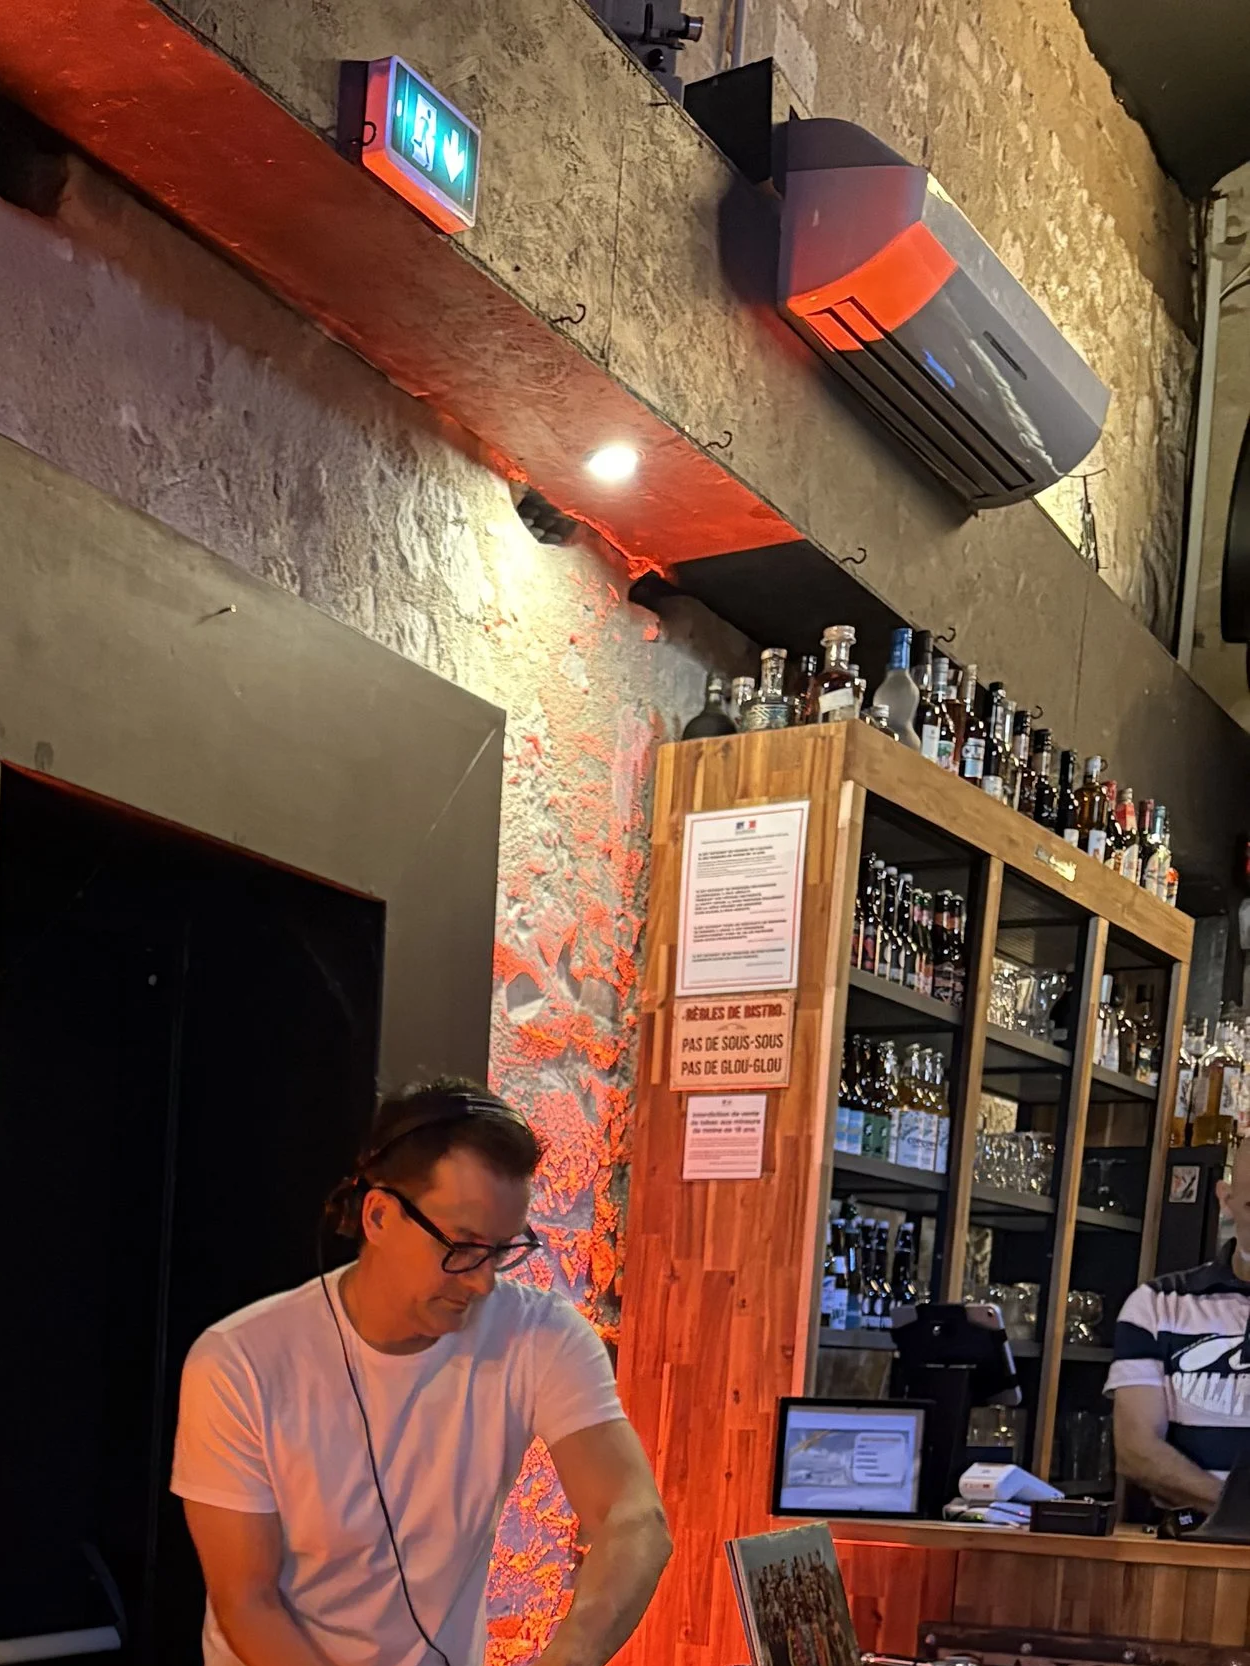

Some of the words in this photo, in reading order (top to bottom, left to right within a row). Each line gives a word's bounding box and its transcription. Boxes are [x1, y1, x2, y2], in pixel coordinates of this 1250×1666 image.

[727, 1006, 742, 1020] DE
[744, 1003, 782, 1019] BISTRO
[681, 1036, 703, 1053] PAS
[705, 1035, 720, 1052] DE
[721, 1034, 784, 1051] SOUS-SOUS
[681, 1060, 703, 1076] PAS
[704, 1060, 719, 1075] DE
[720, 1058, 782, 1074] GLOU-GLOU
